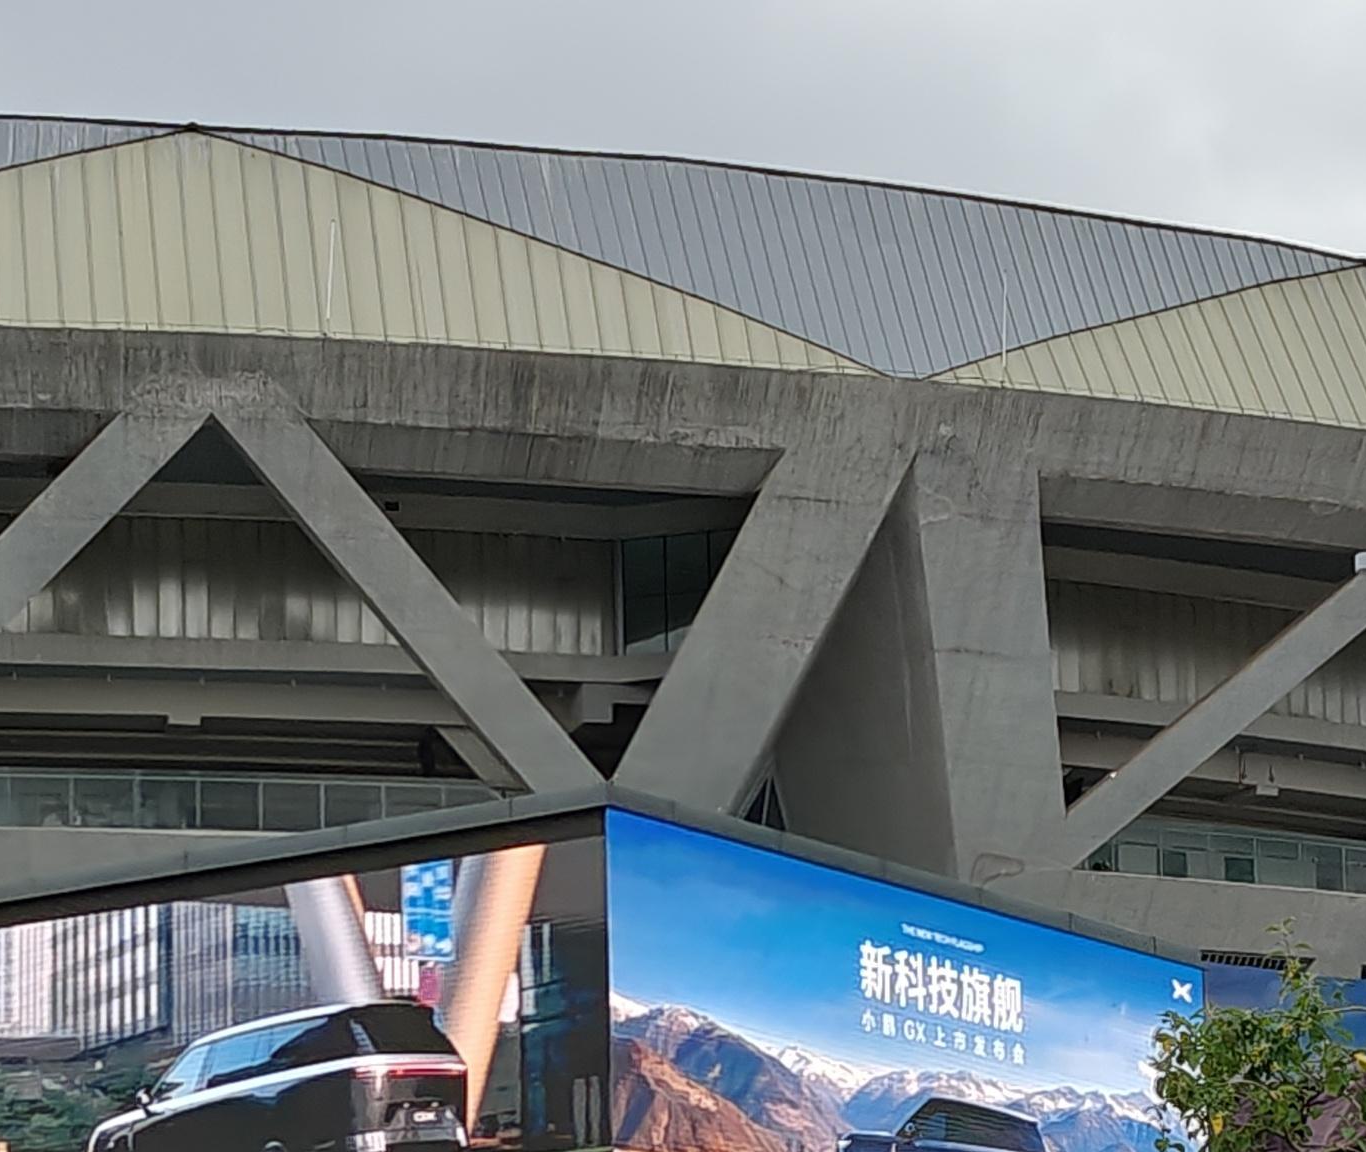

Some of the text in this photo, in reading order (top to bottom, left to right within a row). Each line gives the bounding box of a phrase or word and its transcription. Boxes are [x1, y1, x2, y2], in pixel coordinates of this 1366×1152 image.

[859, 939, 1023, 1033] 新科技旗舰
[903, 1019, 926, 1043] GX
[933, 1025, 1025, 1065] 上市发布会
